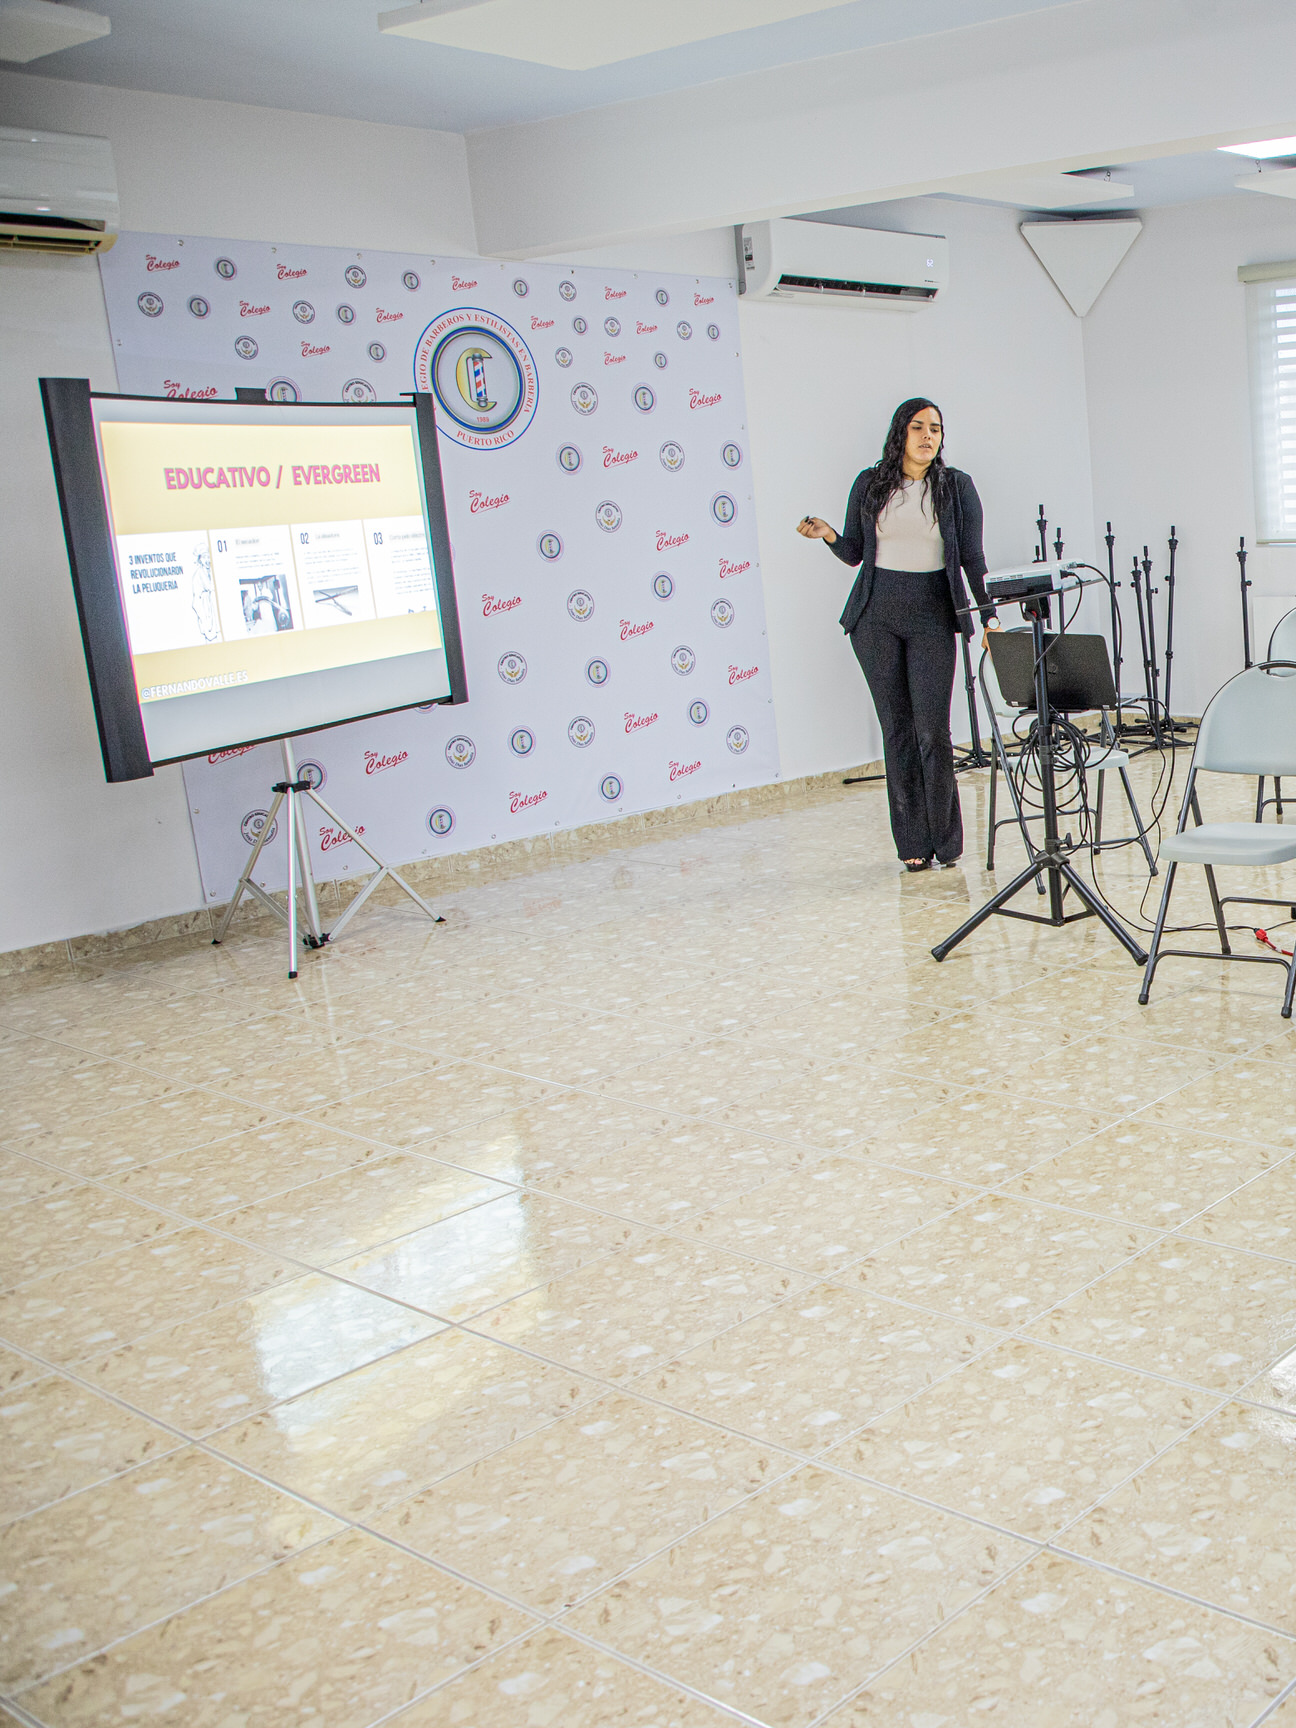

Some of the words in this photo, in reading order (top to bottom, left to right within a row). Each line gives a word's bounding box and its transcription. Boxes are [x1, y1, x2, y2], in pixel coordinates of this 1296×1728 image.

[147, 260, 180, 272] Colegio
[278, 269, 308, 280] Colegio
[453, 281, 478, 292] Colegio
[606, 291, 627, 301] Colegio
[695, 297, 714, 307] Colegio
[241, 305, 271, 318] Colegio
[466, 313, 472, 321] Y
[377, 312, 404, 324] Colegio
[425, 314, 465, 347] BARBEROS
[474, 314, 521, 347] ESTILISTAS
[532, 320, 555, 330] Colegio
[637, 325, 658, 335] Colegio
[302, 346, 331, 358] Colegio
[421, 347, 429, 363] DE
[518, 348, 529, 362] EN
[605, 356, 626, 366] Colegio
[163, 379, 181, 389] Soy
[419, 365, 429, 392] EGIO
[523, 363, 535, 413] BARBERIA
[689, 388, 700, 396] Soy
[690, 394, 722, 410] Colegio
[456, 430, 492, 446] PUERTO
[494, 430, 515, 444] RICO
[602, 446, 614, 455] Soy
[603, 450, 638, 469] Colegio
[164, 466, 271, 490] EDUCATIVO
[292, 463, 381, 486] EVERGREEN
[469, 490, 482, 499] Soy
[470, 494, 510, 514] Colegio
[300, 532, 310, 544] 02
[373, 532, 383, 545] 03
[656, 530, 667, 538] Soy
[217, 540, 228, 553] 01
[657, 534, 690, 551] Colegio
[128, 555, 134, 565] 3
[134, 553, 164, 565] INVENTOS
[165, 551, 177, 563] QUE
[719, 558, 729, 566] Soy
[130, 565, 184, 580] REVOLUCIONARON
[720, 561, 751, 579] Colegio
[132, 583, 141, 594] LA
[482, 594, 495, 603] Soy
[483, 597, 522, 618] Colegio
[619, 619, 630, 628] Soy
[620, 621, 654, 642] Colegio
[729, 666, 759, 685] Colegio
[141, 670, 249, 699] @FERNANDOVALLE.ES
[624, 712, 635, 721] Soy
[625, 713, 658, 736] Colegio
[364, 750, 378, 759] Soy
[365, 751, 408, 775] Colegio
[669, 761, 680, 769] Soy
[670, 761, 702, 782] Colegio
[509, 790, 521, 799] Soy
[510, 790, 548, 814] Colegio
[319, 826, 334, 836] Soy
